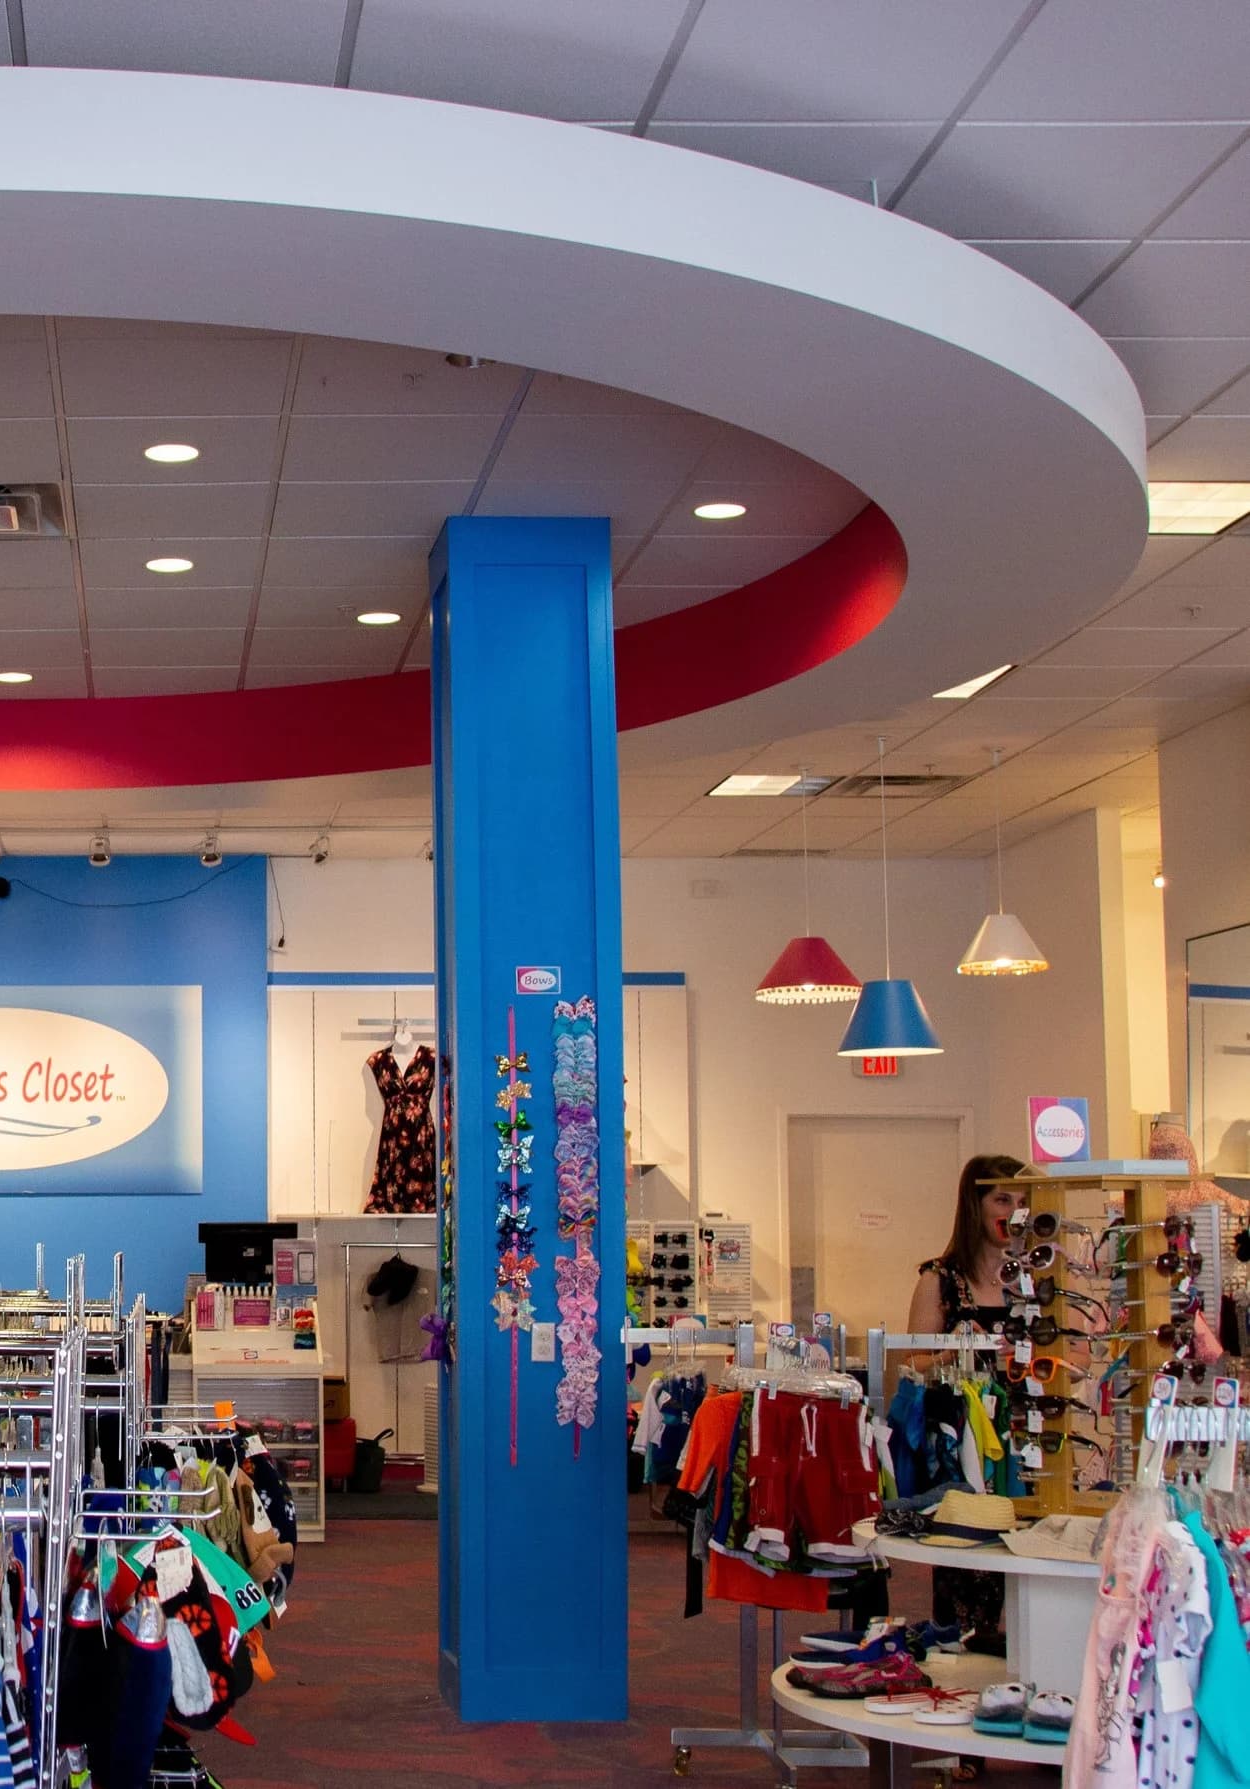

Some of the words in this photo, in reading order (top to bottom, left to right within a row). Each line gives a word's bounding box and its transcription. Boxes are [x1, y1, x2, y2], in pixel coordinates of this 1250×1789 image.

[524, 975, 553, 985] Bows
[862, 1055, 898, 1075] EXIT
[22, 1057, 115, 1103] Closet
[1036, 1125, 1086, 1138] Accessories
[234, 1581, 262, 1610] 86
